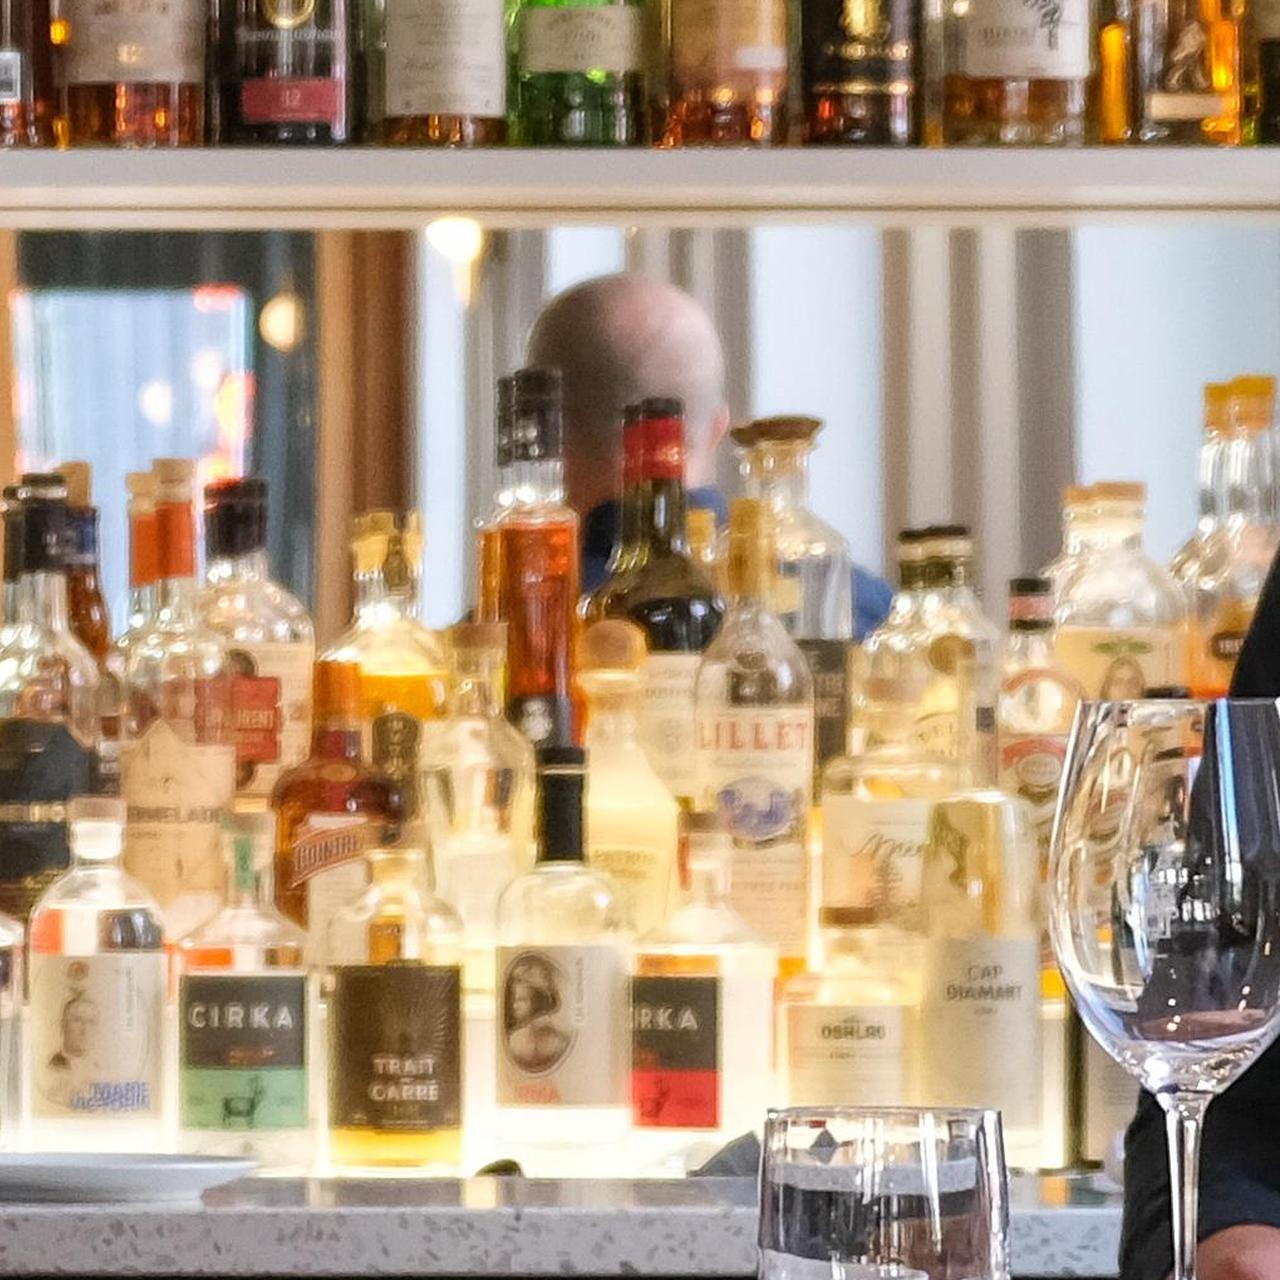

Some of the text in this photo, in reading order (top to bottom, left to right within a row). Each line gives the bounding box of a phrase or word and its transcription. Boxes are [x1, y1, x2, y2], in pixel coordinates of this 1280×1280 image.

[697, 719, 809, 751] LILLET
[189, 1003, 294, 1029] CIRKA
[640, 1006, 700, 1031] RKA
